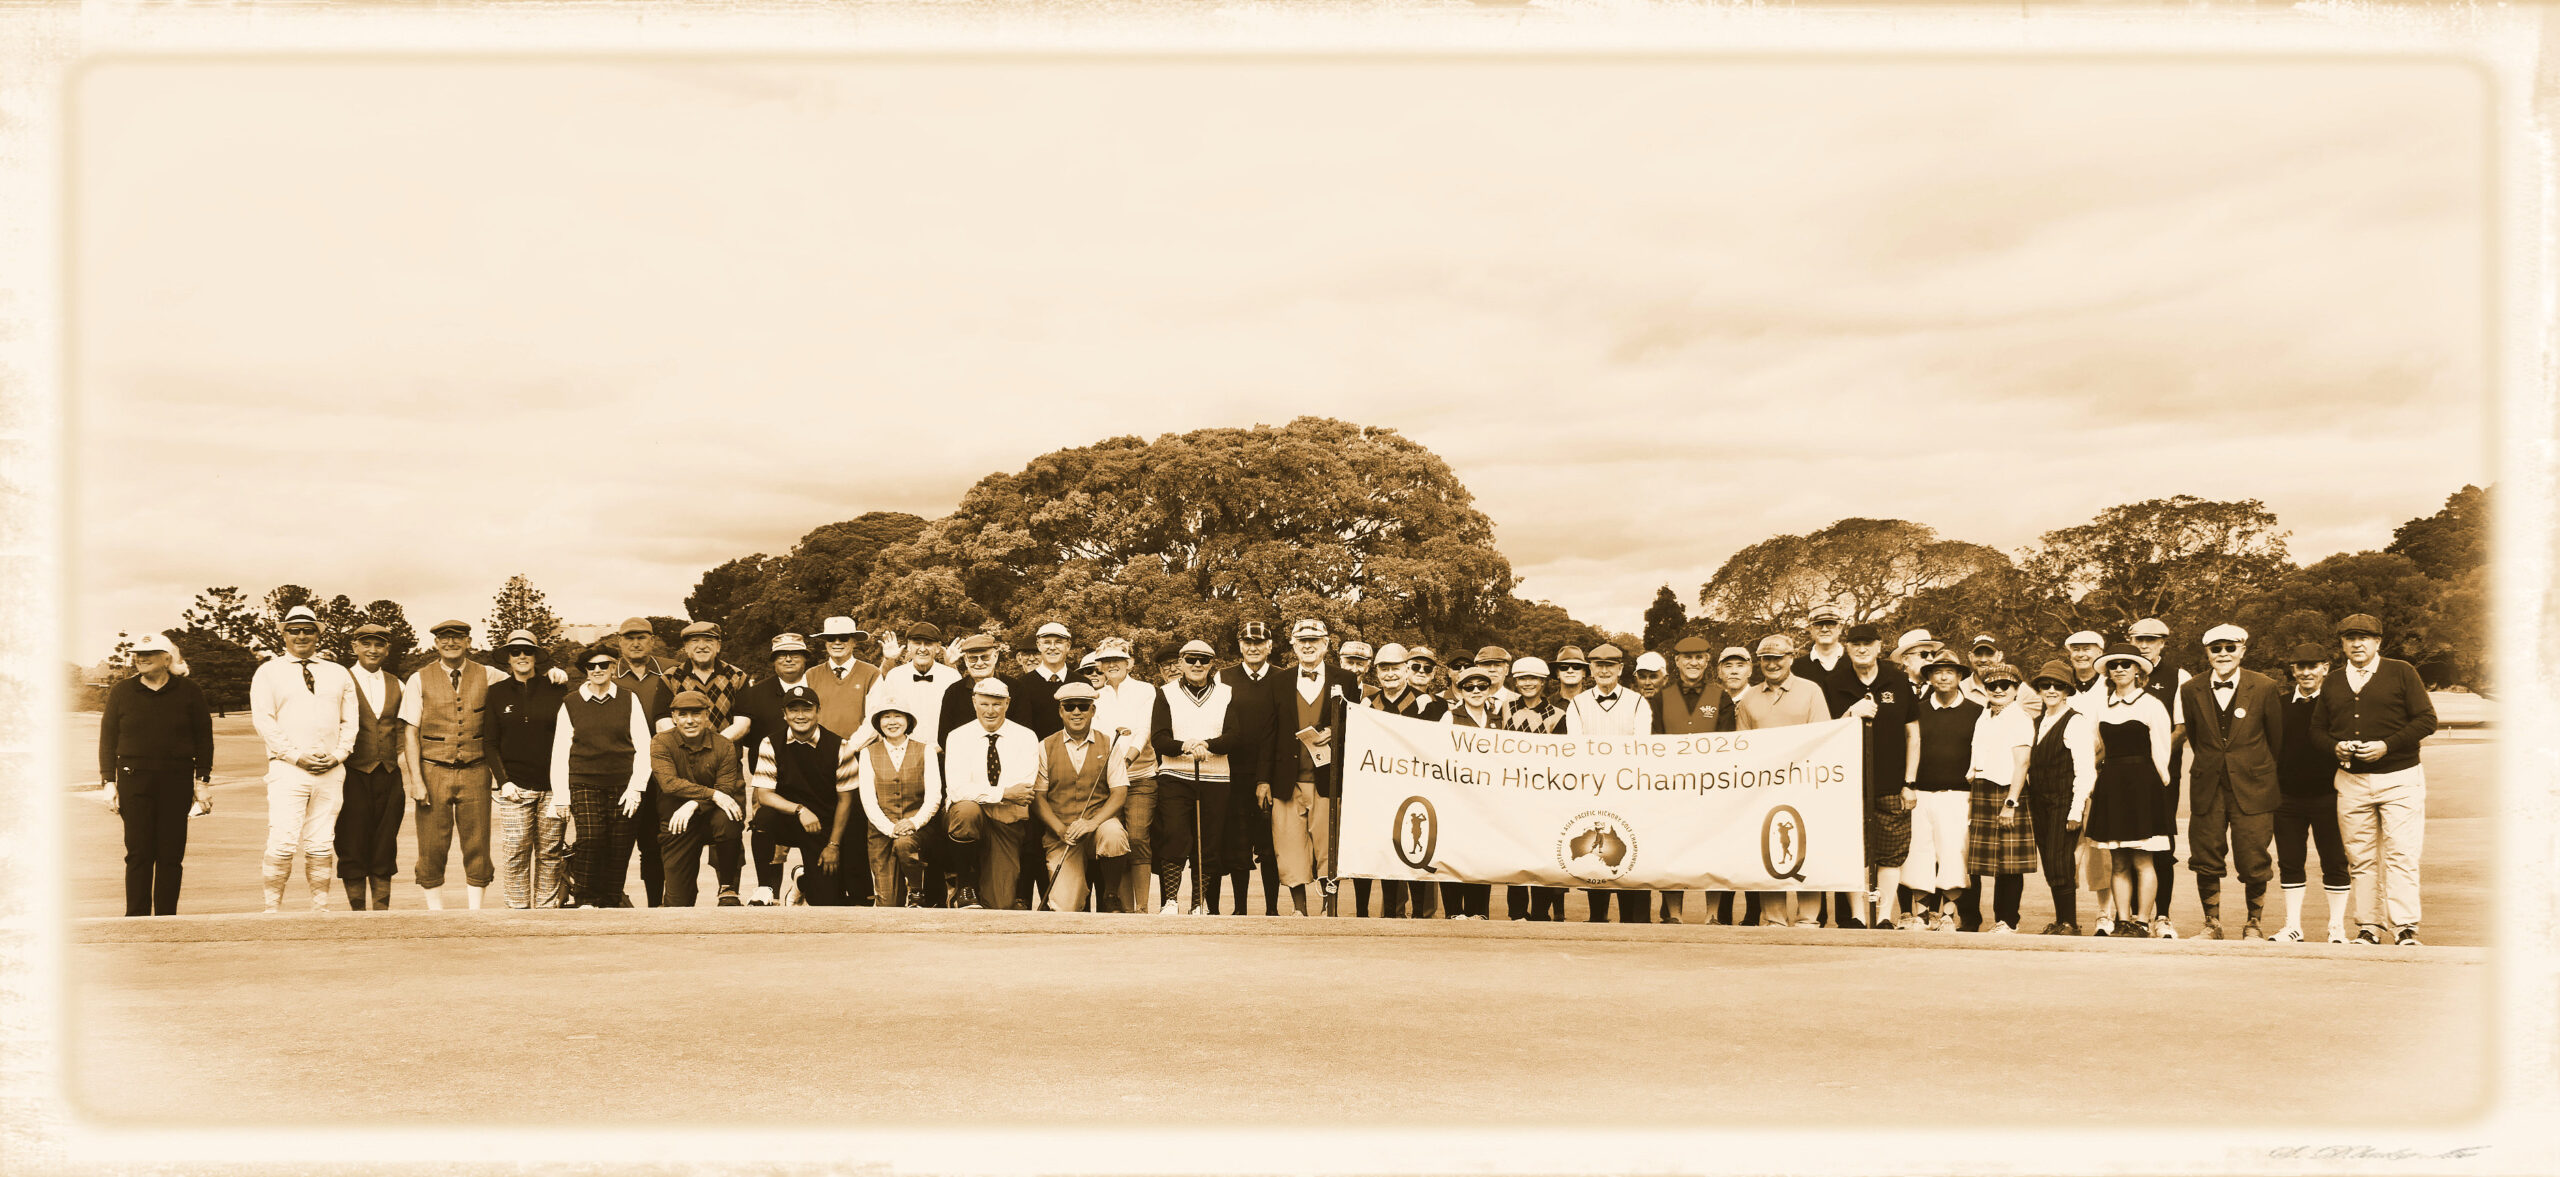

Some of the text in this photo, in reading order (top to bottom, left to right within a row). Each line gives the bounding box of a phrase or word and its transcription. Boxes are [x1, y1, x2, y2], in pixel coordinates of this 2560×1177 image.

[1450, 731, 1750, 758] Welcome to the 2026
[1359, 749, 1845, 796] Australian Hickory Champsionships
[1392, 795, 1438, 874] Q
[1563, 820, 1575, 831] ASIA
[1574, 810, 1596, 821] PACIFIC
[1597, 810, 1622, 822] HICKORY
[1621, 820, 1633, 833] GOLF
[1761, 804, 1807, 883] Q
